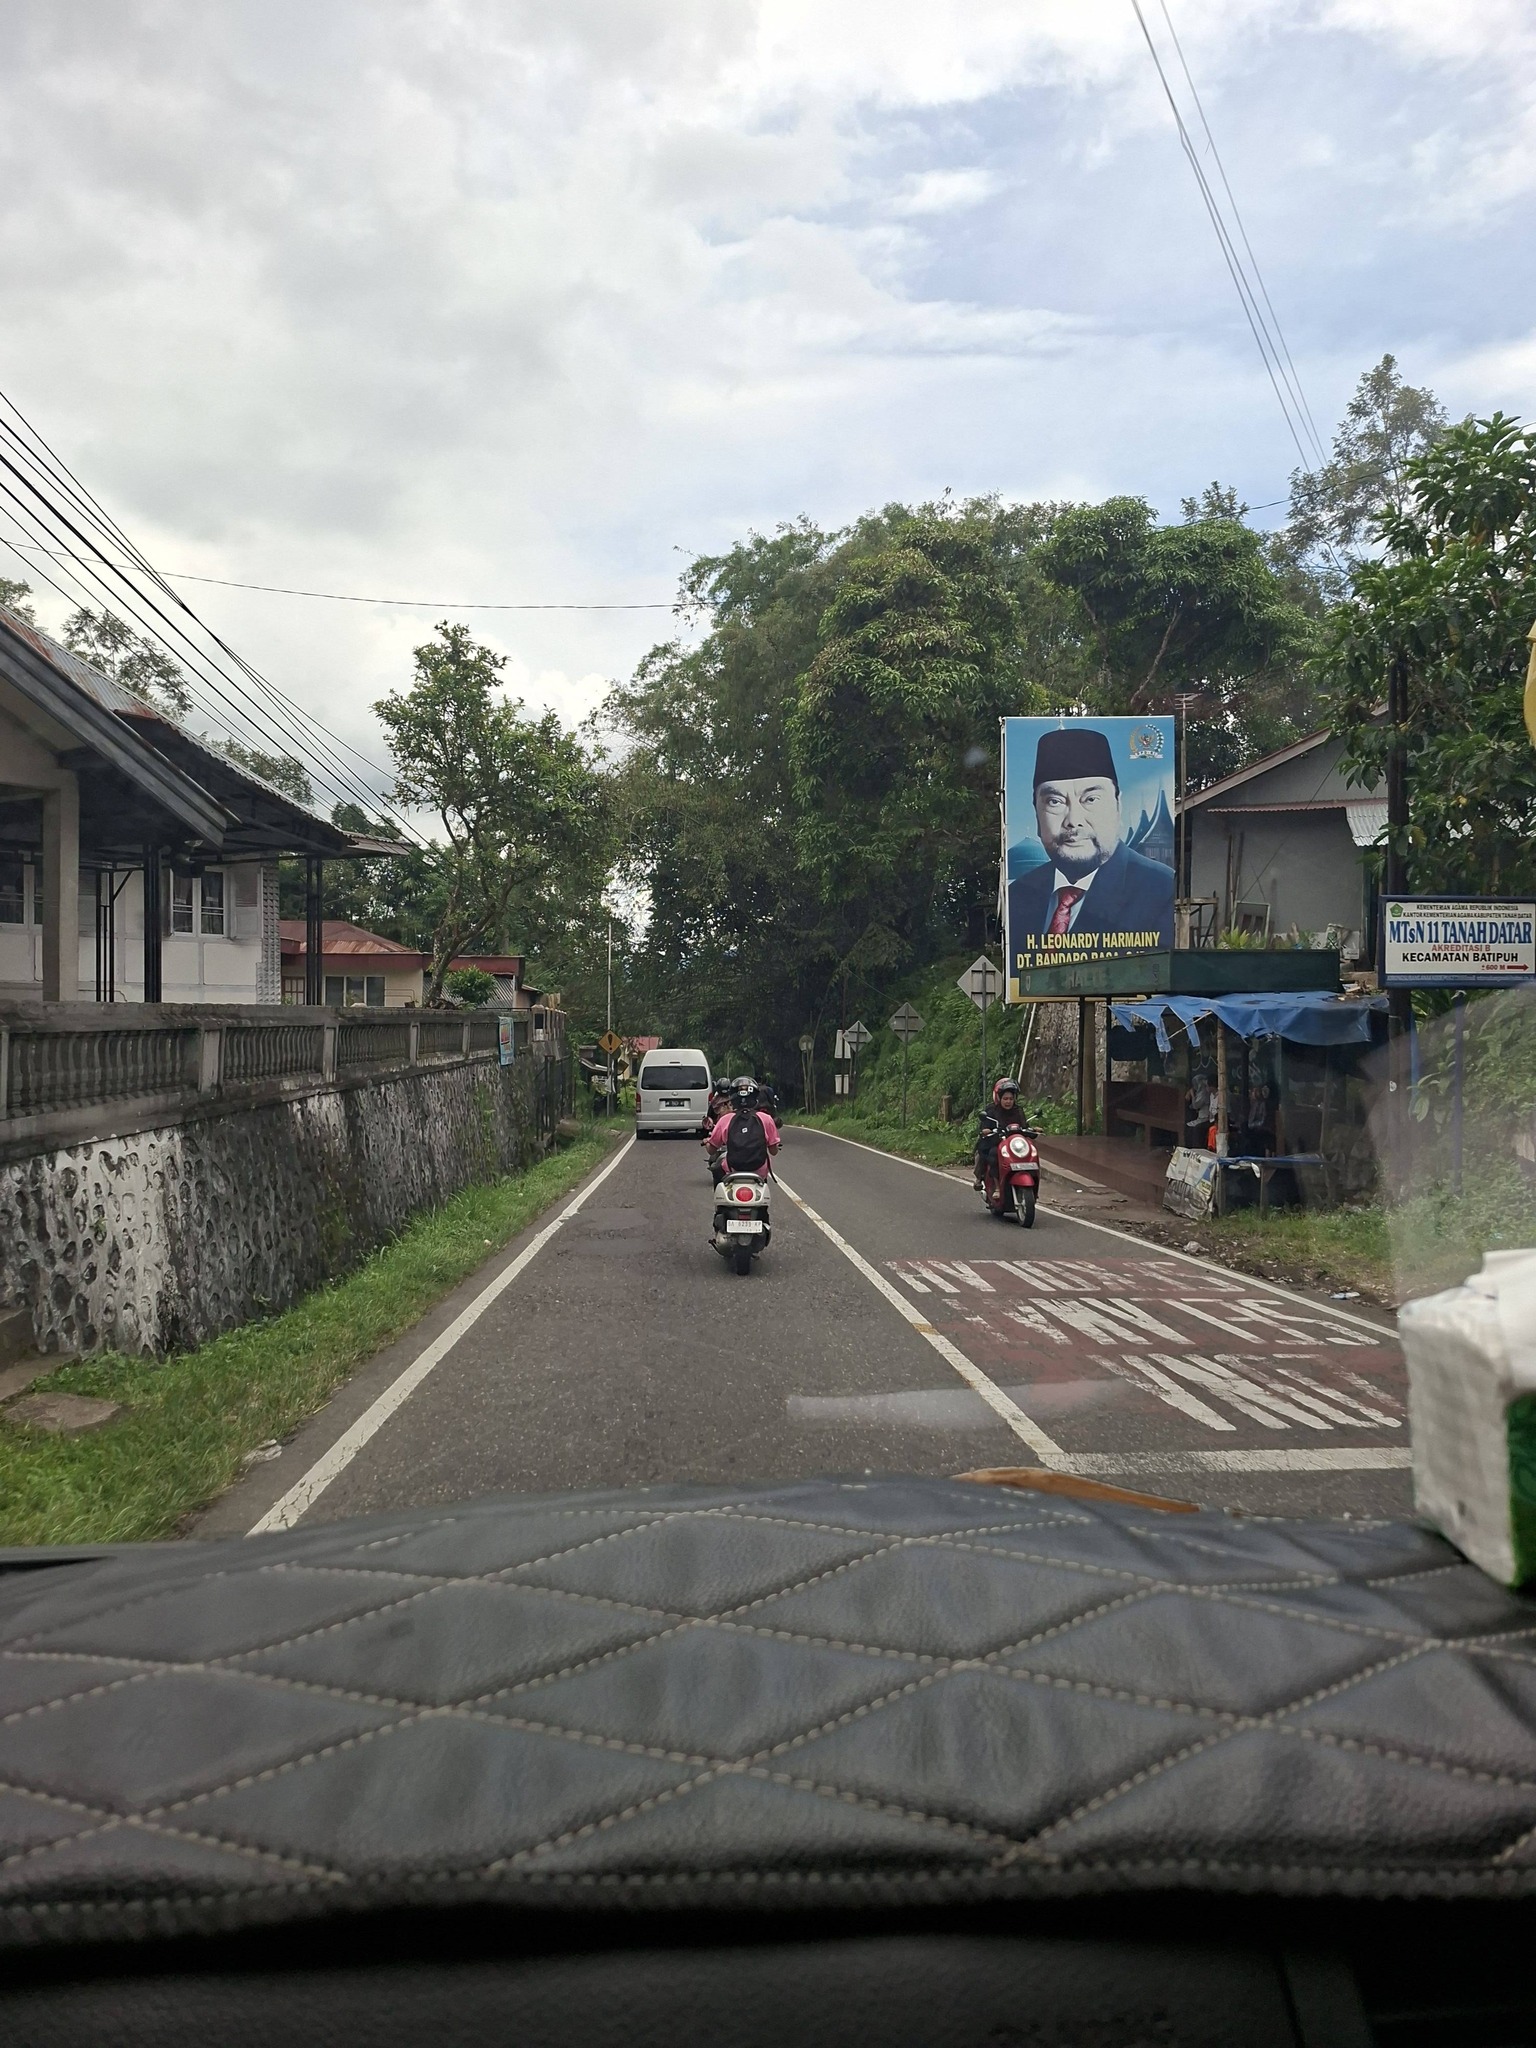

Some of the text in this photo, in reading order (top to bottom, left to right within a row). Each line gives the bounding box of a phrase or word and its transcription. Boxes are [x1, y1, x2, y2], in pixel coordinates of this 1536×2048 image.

[1027, 931, 1160, 949] H. LEONARDY HARMAINY
[1389, 920, 1532, 944] MTsN 11 TANAH DATAR
[1431, 944, 1491, 952] AKREDITASI B
[1016, 953, 1033, 969] DT.
[1402, 952, 1518, 962] KECAMATAN BATIPUH
